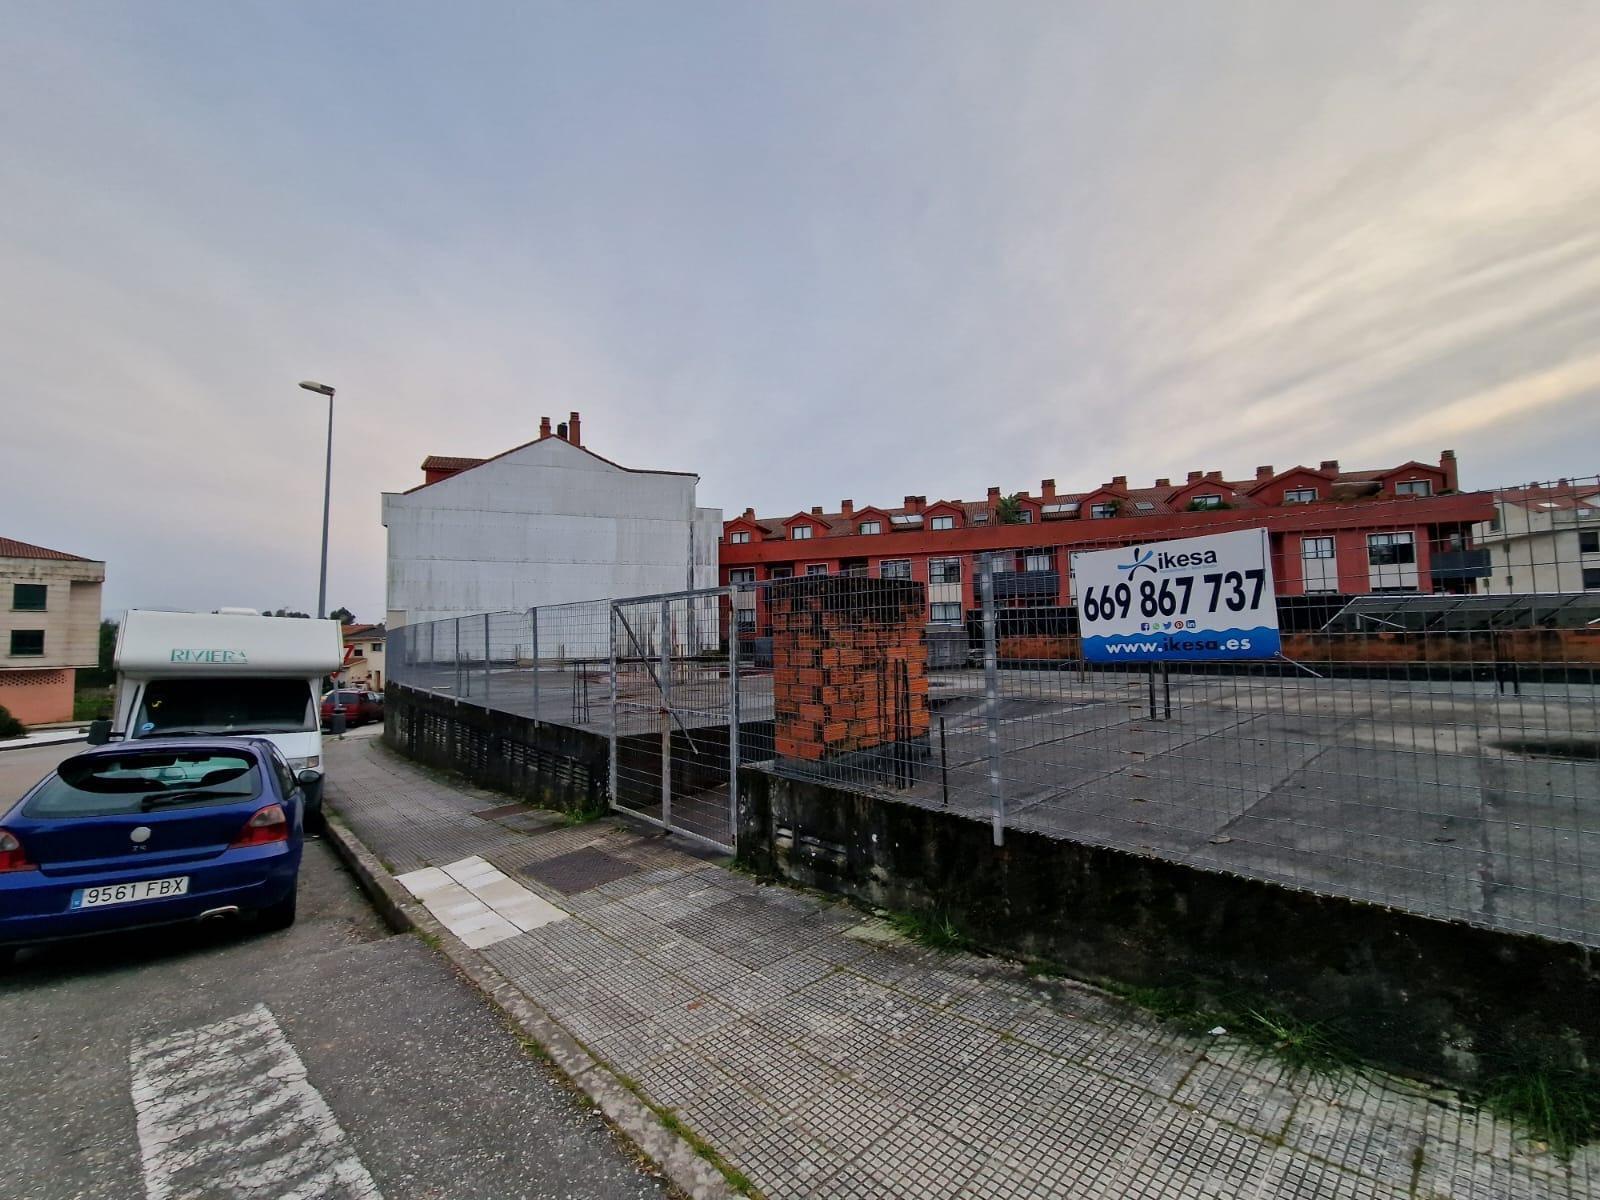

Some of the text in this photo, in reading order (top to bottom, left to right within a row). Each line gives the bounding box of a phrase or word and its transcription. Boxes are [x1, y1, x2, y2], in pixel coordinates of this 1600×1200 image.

[1158, 550, 1217, 569] ikesa
[1084, 568, 1266, 622] 669 867 737
[1106, 637, 1251, 654] www.ikesa.es
[170, 648, 248, 663] RIVIERA
[87, 878, 184, 904] 9561 FBX
